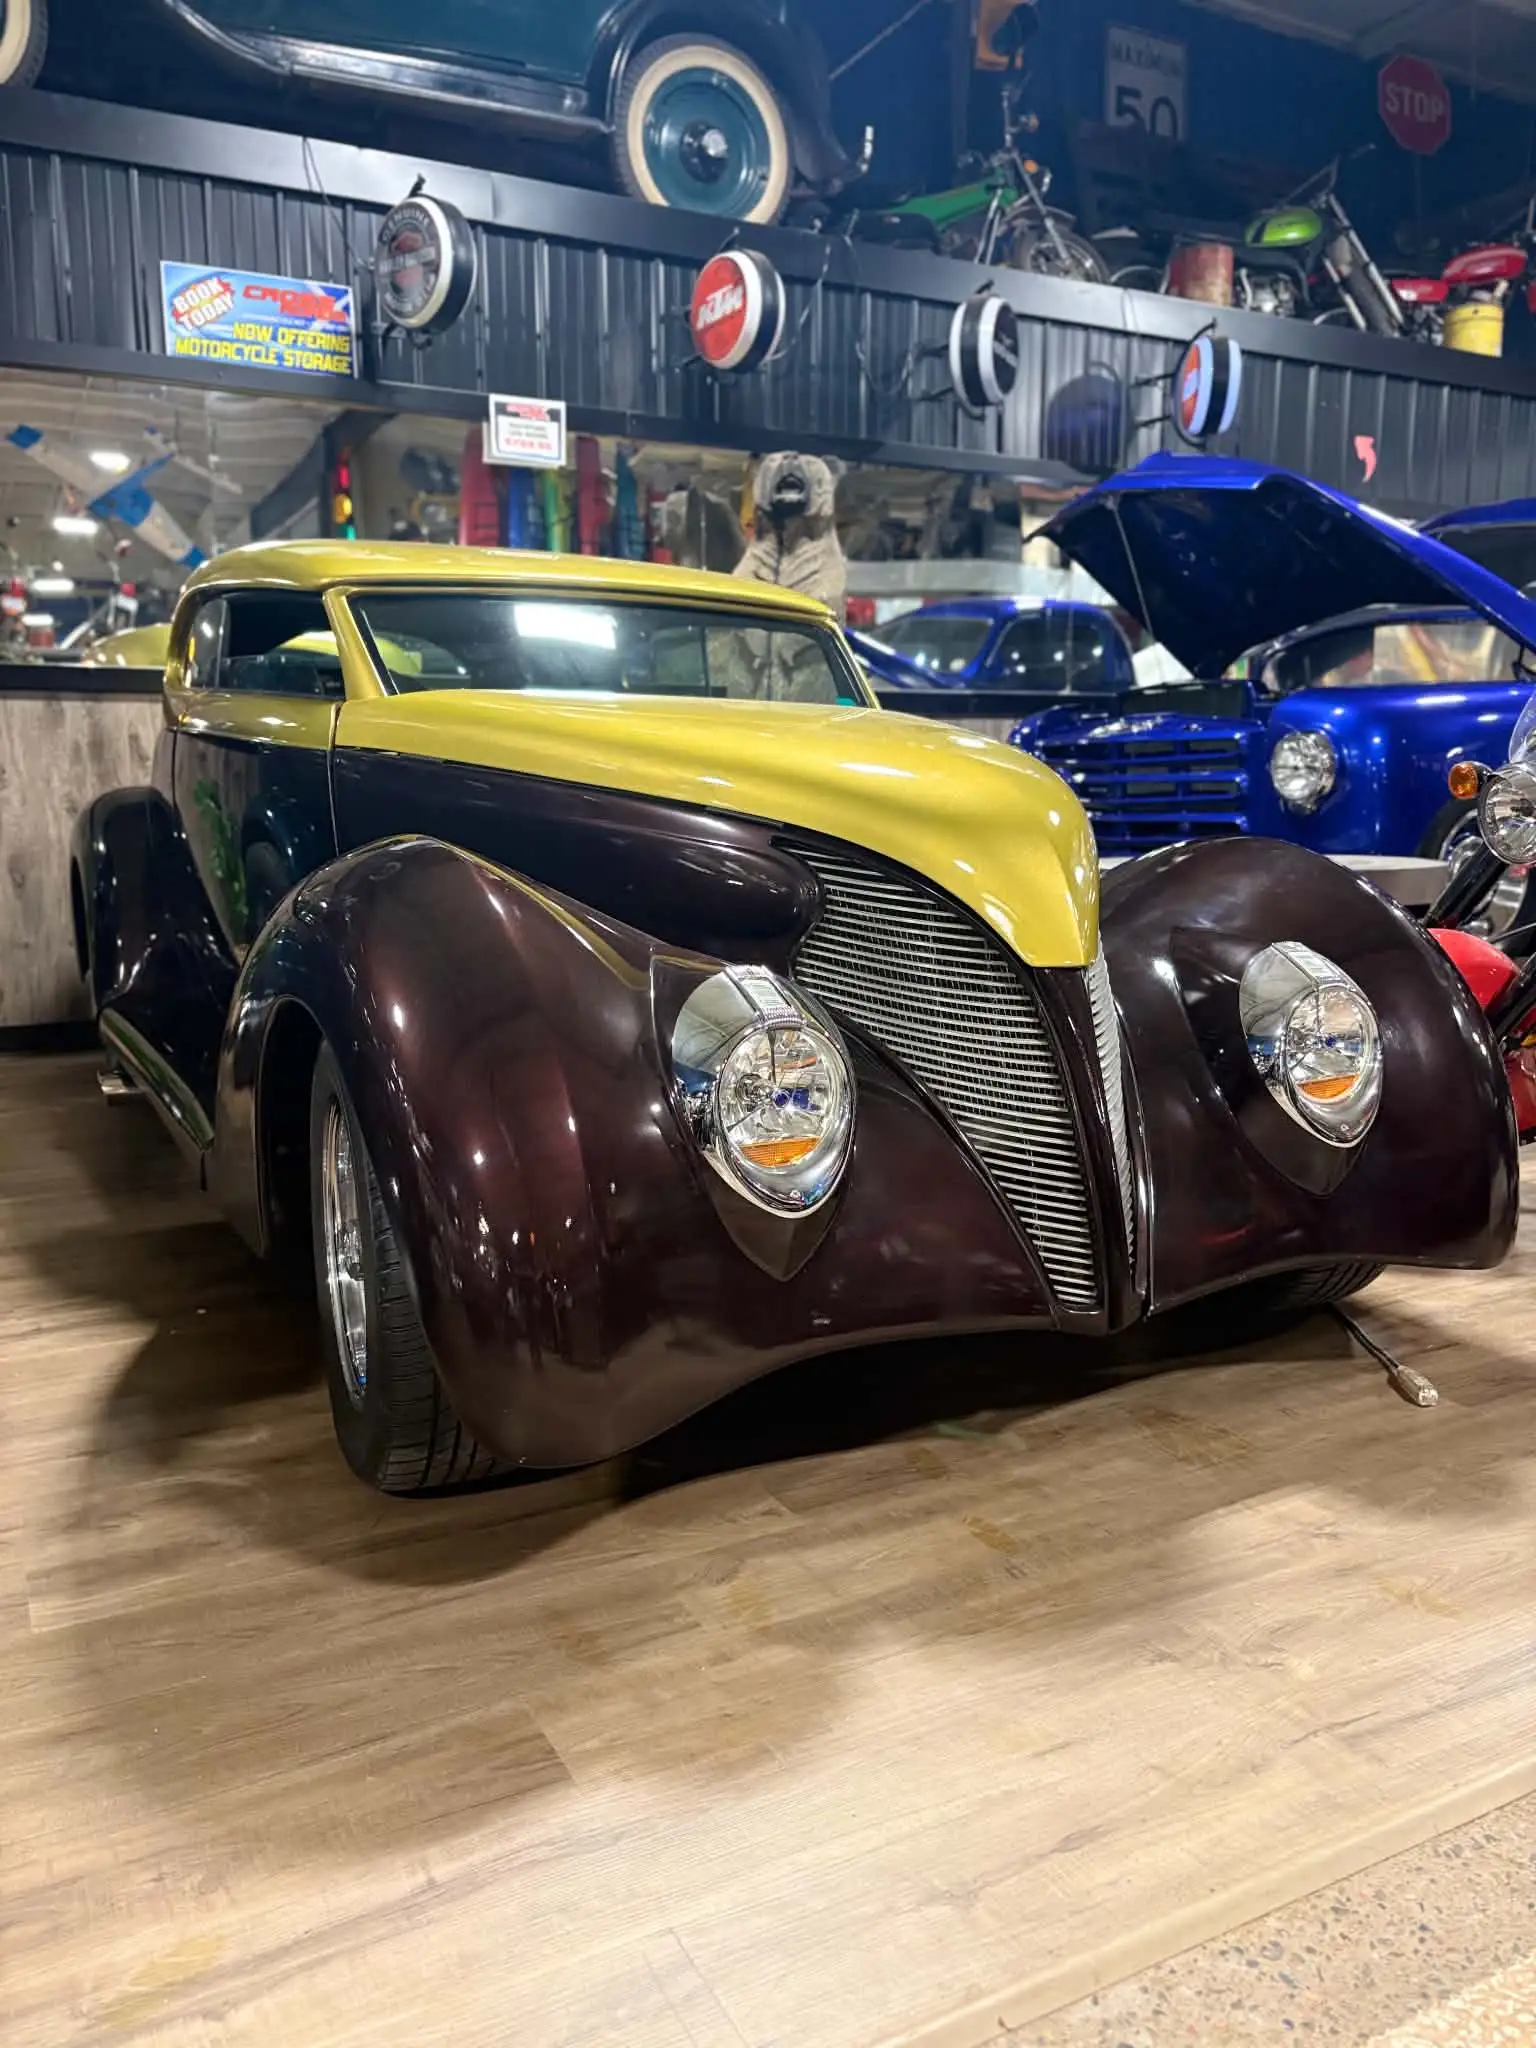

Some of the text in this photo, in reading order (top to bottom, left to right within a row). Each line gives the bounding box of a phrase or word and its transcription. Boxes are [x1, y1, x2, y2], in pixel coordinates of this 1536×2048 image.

[1116, 85, 1178, 138] 50
[1385, 82, 1444, 122] STOP
[173, 276, 224, 314] BOOK
[179, 292, 235, 332] TODAY
[697, 282, 743, 330] KTM
[175, 335, 352, 375] MOTORCYCLE STORAGE
[232, 321, 273, 343] NOW
[277, 327, 351, 353] OFFERING
